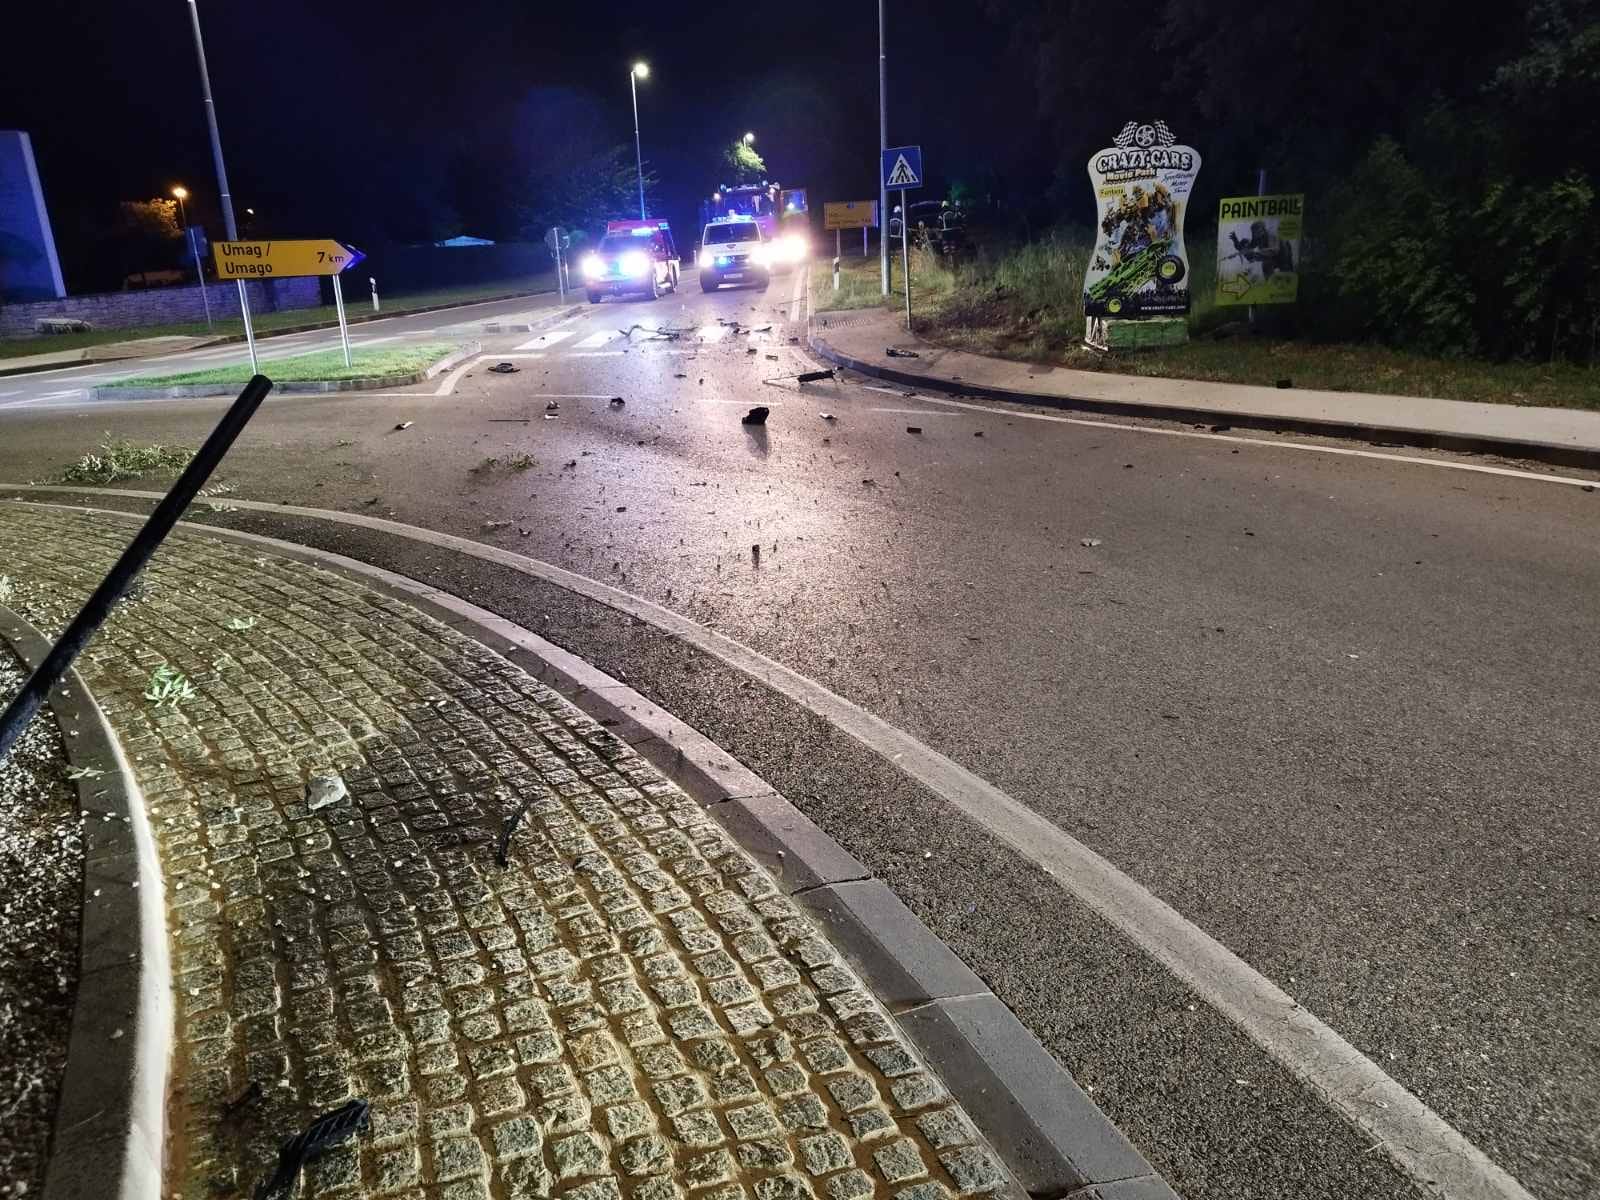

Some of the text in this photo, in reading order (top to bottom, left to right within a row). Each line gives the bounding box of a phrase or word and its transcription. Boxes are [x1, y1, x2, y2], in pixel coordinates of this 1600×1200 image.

[1221, 198, 1302, 219] PAINTBALL
[222, 244, 262, 258] Umag
[317, 252, 345, 263] 7 km
[225, 262, 273, 276] Umago
